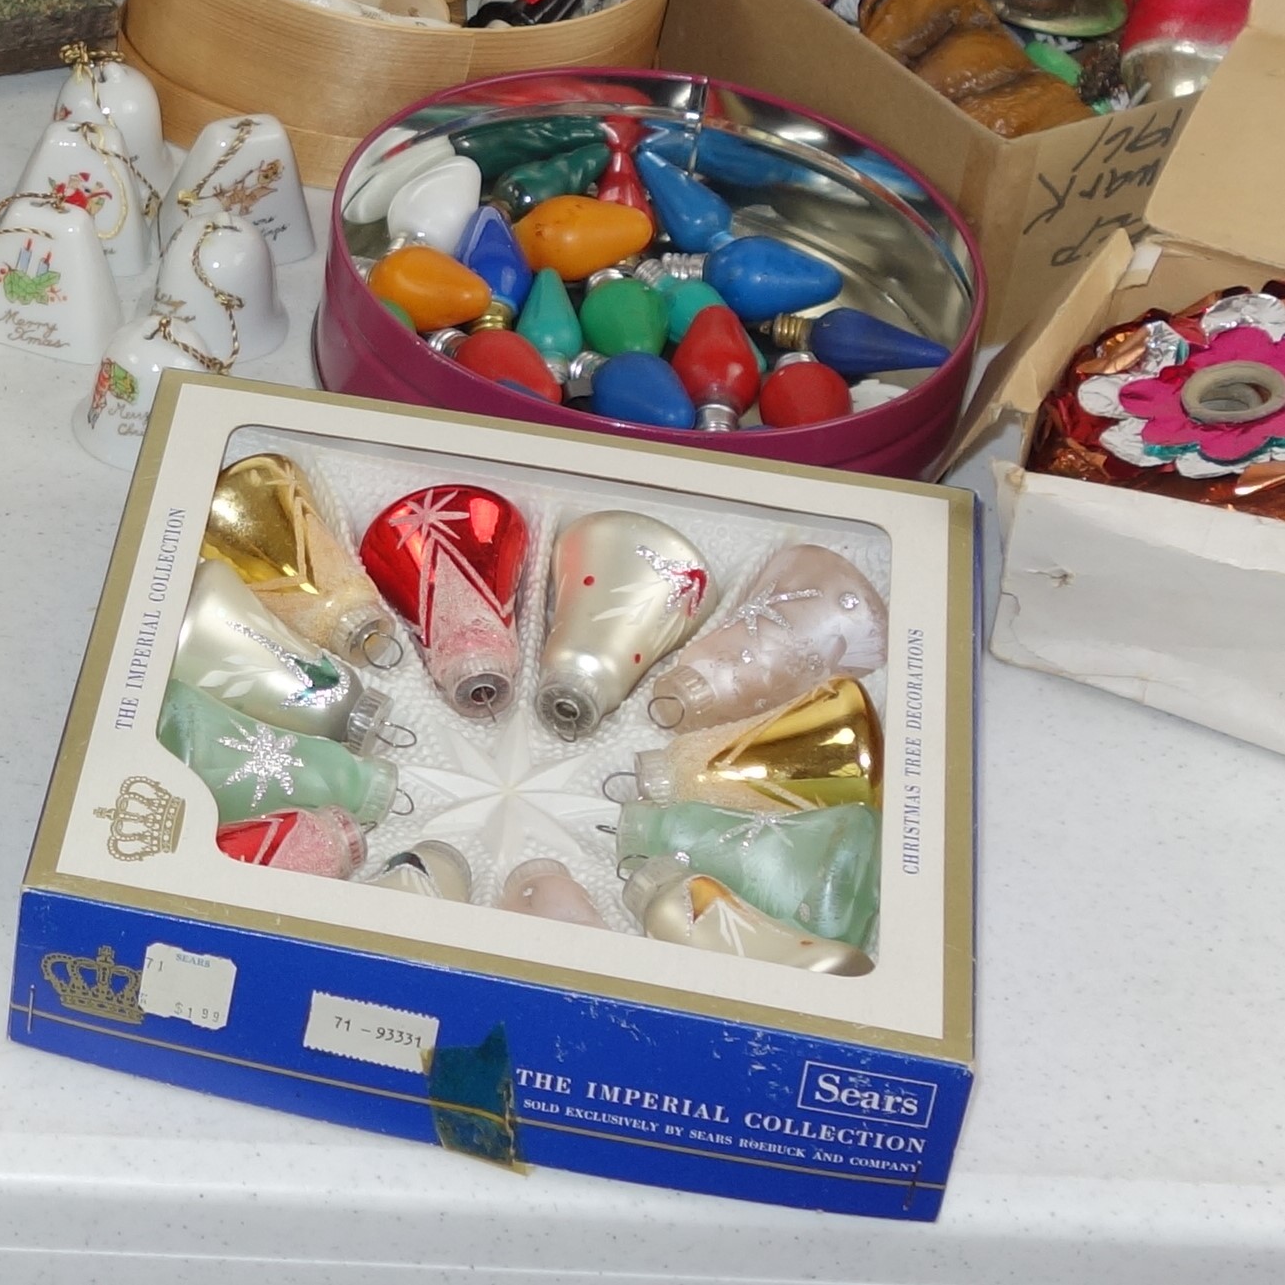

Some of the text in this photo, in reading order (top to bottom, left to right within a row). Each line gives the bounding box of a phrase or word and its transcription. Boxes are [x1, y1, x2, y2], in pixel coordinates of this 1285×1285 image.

[7, 325, 71, 348] Xmas
[115, 507, 186, 730] THE IMPERIAL COLLECTION
[903, 628, 924, 875] CHRISTMAS TREE DECORATIONS
[175, 953, 211, 969] SEARS
[333, 1016, 352, 1032] 71
[516, 1067, 927, 1154] THE IMPERIAL COLLECTION
[814, 1072, 919, 1116] Sears
[523, 1098, 918, 1173] SOLD EXCLUSIVELY BY SEARS ROEBUCK AND COMPANY
